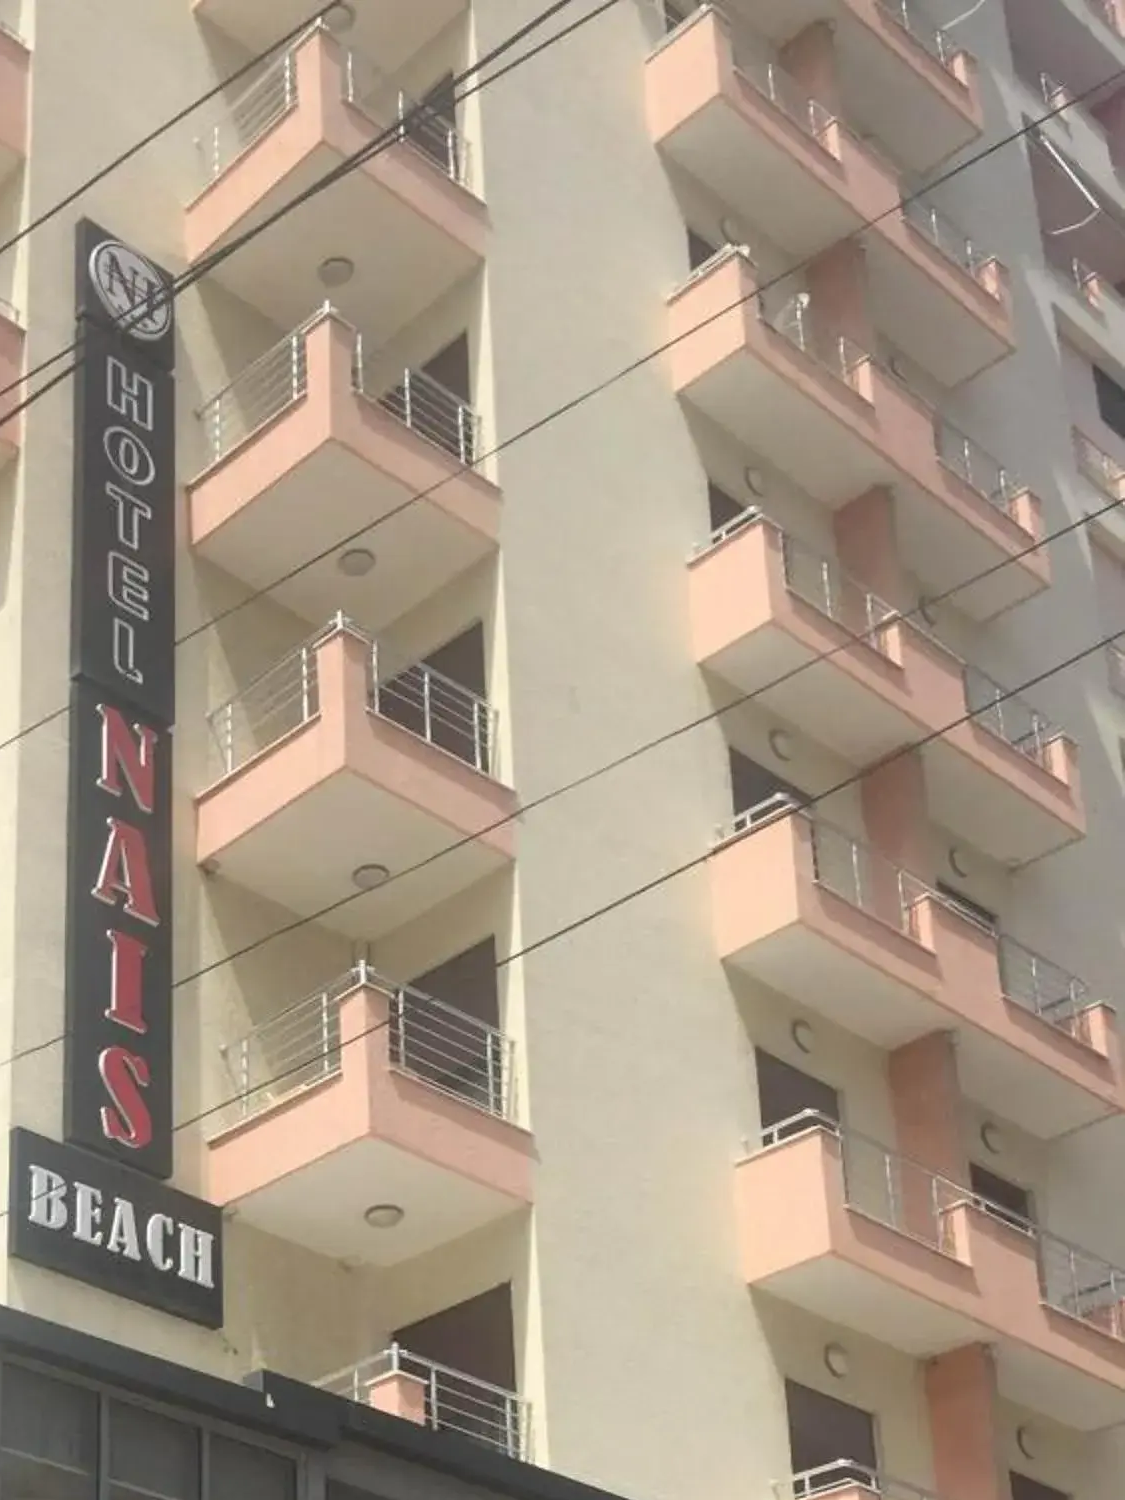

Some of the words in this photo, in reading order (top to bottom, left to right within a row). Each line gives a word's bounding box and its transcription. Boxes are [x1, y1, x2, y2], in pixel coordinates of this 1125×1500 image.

[103, 356, 156, 684] HOTEL
[91, 703, 160, 1150] NAIS
[28, 1163, 217, 1291] BEACH
